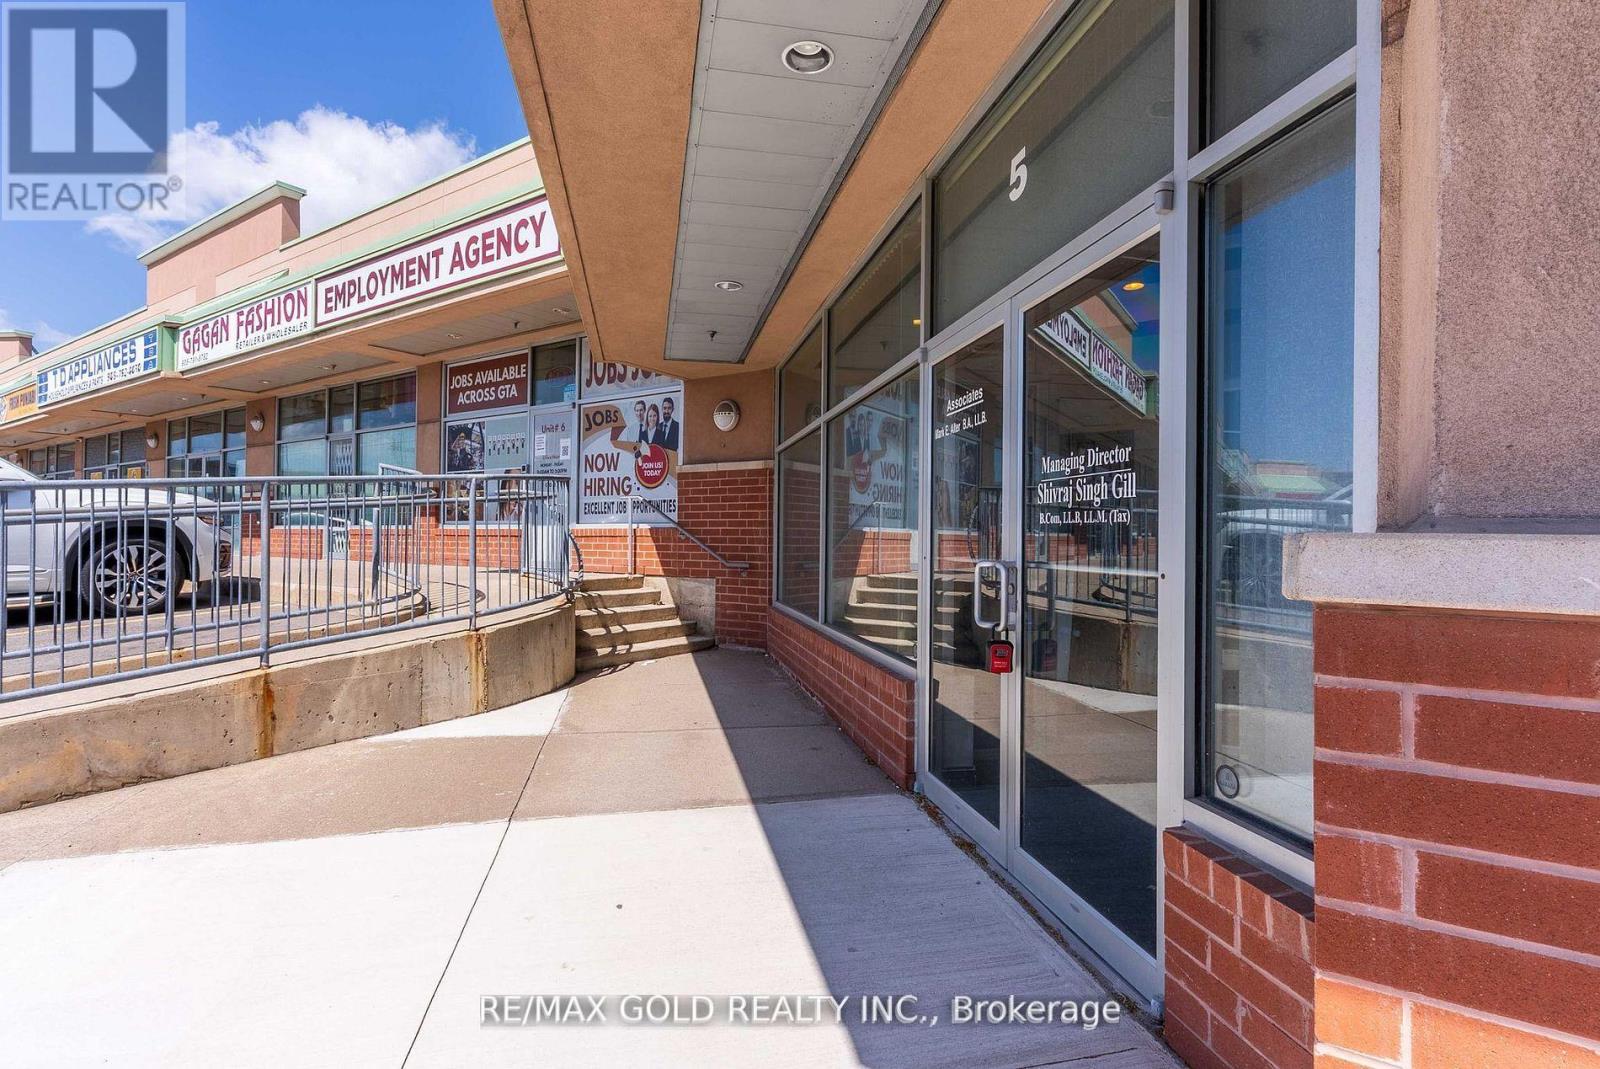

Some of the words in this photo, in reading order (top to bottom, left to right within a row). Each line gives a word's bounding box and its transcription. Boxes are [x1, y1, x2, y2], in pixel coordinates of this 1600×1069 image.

[1009, 145, 1028, 202] 5
[324, 247, 444, 315] EMPLOYMENT
[449, 210, 547, 275] AGENCY
[182, 314, 230, 355] GAGAN
[236, 286, 308, 341] FASHION
[235, 335, 261, 350] RETAILER
[266, 321, 308, 341] WHOLESALER
[68, 339, 137, 383] APPLIANCES
[450, 373, 473, 390] JOBS
[474, 364, 527, 385] AVAILABLE
[457, 386, 496, 405] ACROSS
[497, 384, 518, 400] GTA
[946, 387, 983, 412] Associates
[560, 422, 566, 432] 6
[585, 409, 619, 432] JOBS
[584, 452, 621, 473] NOW
[1041, 451, 1085, 476] Managing
[1086, 444, 1132, 468] Director
[644, 469, 662, 477] TODAY
[583, 475, 632, 497] HIRING
[1037, 479, 1073, 509] Shivraj
[1076, 475, 1108, 507] Singh
[1112, 472, 1137, 499] Gill
[583, 500, 615, 515] EXCELLENT
[615, 500, 627, 514] JOB
[1109, 508, 1131, 526] (Tax)
